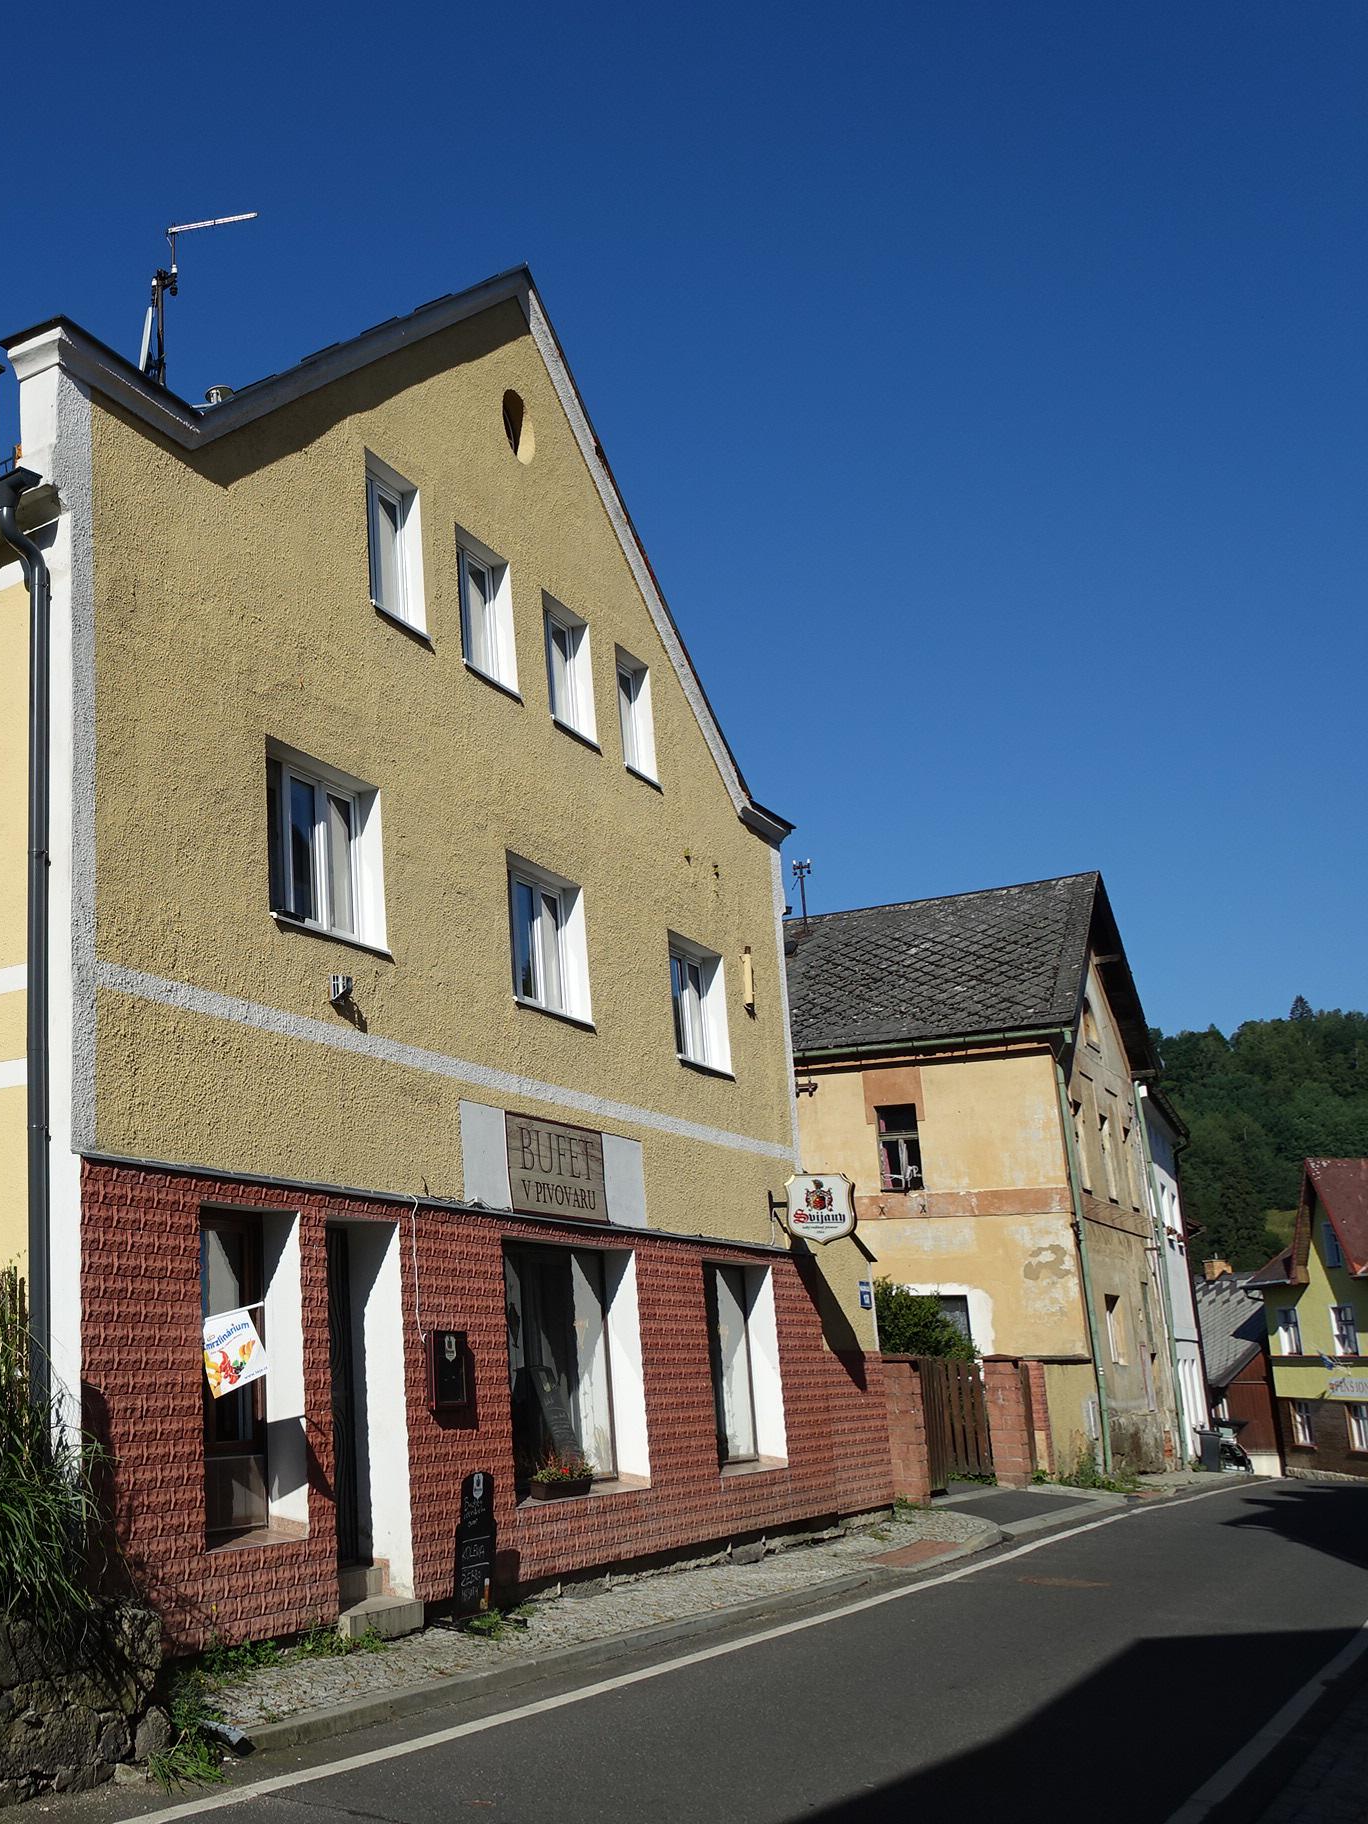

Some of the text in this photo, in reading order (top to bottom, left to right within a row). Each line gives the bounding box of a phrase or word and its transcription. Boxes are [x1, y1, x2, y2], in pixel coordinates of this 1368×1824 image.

[518, 1125, 594, 1181] BUFET
[521, 1179, 596, 1210] V PIVOVARU
[793, 1208, 846, 1224] Svijany
